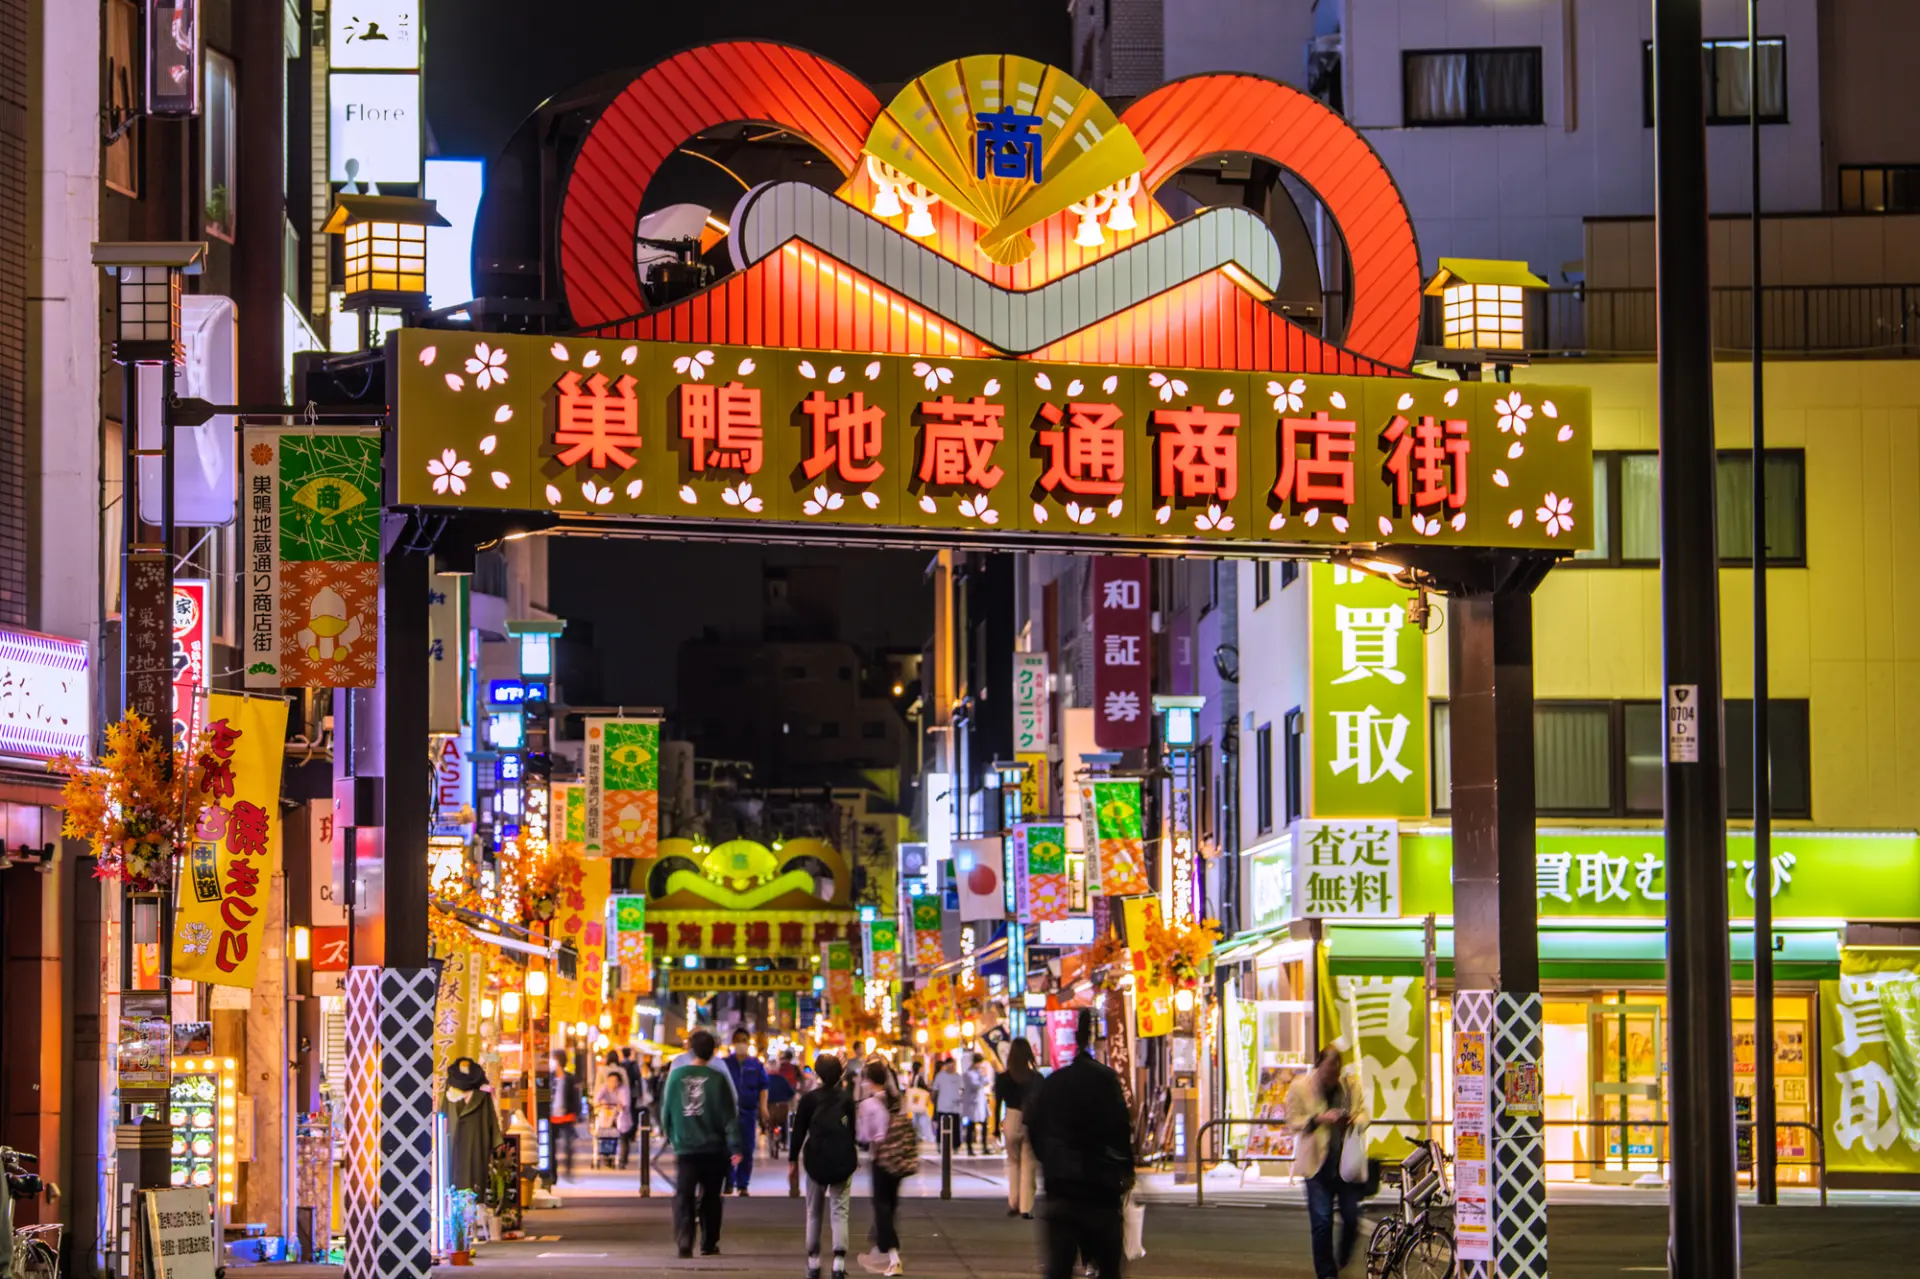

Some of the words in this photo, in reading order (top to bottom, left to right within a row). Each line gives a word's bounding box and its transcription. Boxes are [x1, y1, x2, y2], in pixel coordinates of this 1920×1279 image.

[343, 16, 389, 44] 江
[346, 104, 405, 121] Flore
[976, 105, 1043, 184] 商
[555, 370, 1470, 508] 巣鴨地蔵通商店街
[316, 486, 341, 510] 商
[252, 475, 272, 652] 巣鴨地蔵通り商店街
[173, 598, 192, 614] 家
[1103, 580, 1141, 723] 和証券
[1329, 561, 1413, 785] 買取
[1019, 669, 1035, 748] クリニック
[1670, 706, 1695, 721] 0704
[1677, 723, 1687, 735] D
[1022, 764, 1037, 821] 漢方
[1305, 825, 1391, 866] 査定
[1305, 871, 1393, 913] 無料
[1537, 851, 1797, 903] 買取むび
[319, 940, 349, 965] ス
